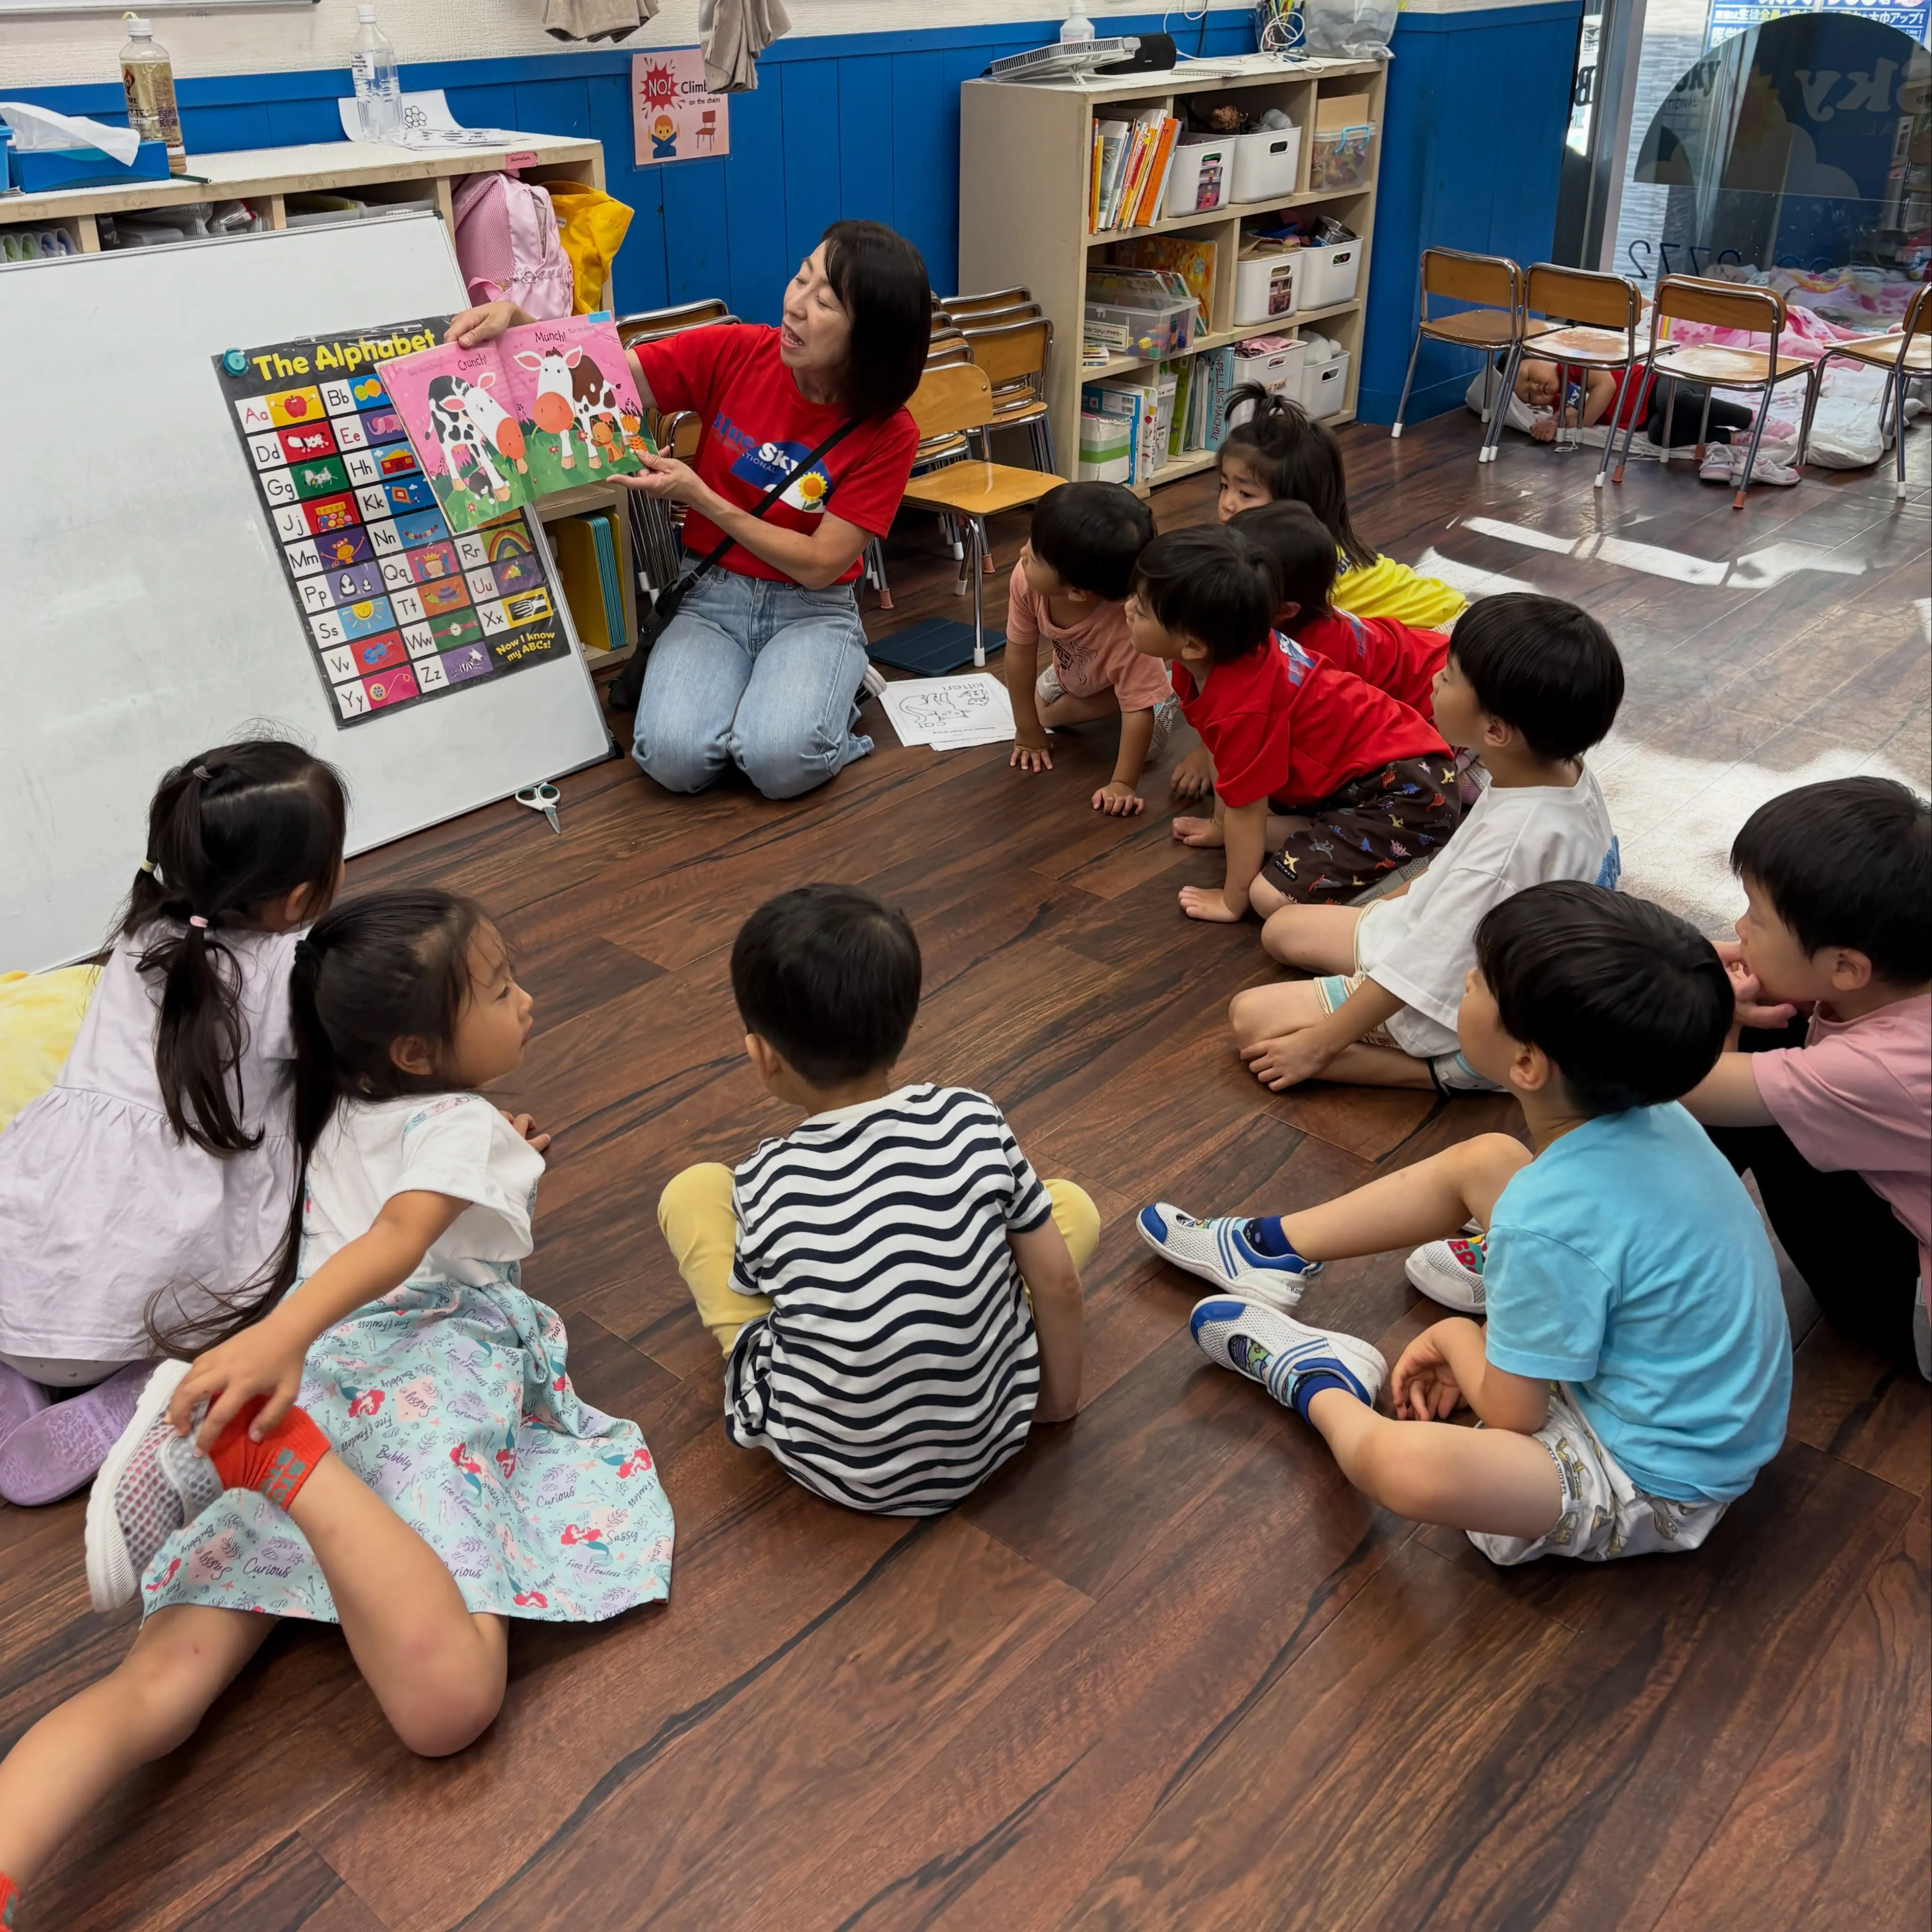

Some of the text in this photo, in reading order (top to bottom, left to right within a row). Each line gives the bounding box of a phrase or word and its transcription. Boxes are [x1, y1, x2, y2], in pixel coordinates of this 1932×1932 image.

[648, 76, 672, 97] NO!
[535, 330, 567, 342] Munch!
[253, 353, 309, 381] The
[315, 328, 435, 372] Alphabet
[328, 390, 349, 406] Bb
[245, 408, 268, 424] Aa
[1210, 405, 1224, 442] MACHINE
[340, 428, 360, 444] Ee
[256, 443, 280, 463] Dd
[350, 459, 373, 477] Hh
[267, 479, 296, 500] Gg
[363, 494, 384, 511] Kk
[283, 510, 305, 536] Jj
[374, 528, 396, 545] Nn
[290, 550, 319, 569] Mm
[462, 543, 481, 559] Rr
[383, 564, 413, 584] Qq
[473, 578, 493, 595] Uu
[304, 586, 327, 607] Pp
[398, 598, 416, 614] Tt
[484, 611, 504, 628] Xx
[319, 623, 339, 640] Ss
[406, 634, 433, 652] Ww
[496, 633, 555, 655] Now I know
[507, 640, 550, 661] my ABCs!
[333, 655, 350, 673] Vv
[421, 666, 441, 683] Zz
[341, 691, 364, 712] Yy
[444, 1348, 460, 1361] Free
[381, 1371, 418, 1388] Bubbly
[404, 1391, 438, 1417] Sassy
[446, 1401, 485, 1424] Curious
[376, 1445, 412, 1471] Bubbly
[530, 1447, 560, 1455] Fearless
[439, 1480, 454, 1497] Free
[457, 1501, 483, 1528] Fearless
[537, 1486, 576, 1508] Curious
[628, 1481, 654, 1508] Fearless
[181, 1524, 217, 1554] Bubbly
[607, 1529, 639, 1545] Sassy
[198, 1550, 233, 1580] Sassy
[243, 1557, 293, 1578] Curious
[566, 1559, 583, 1569] Free
[590, 1565, 622, 1577] Fearless
